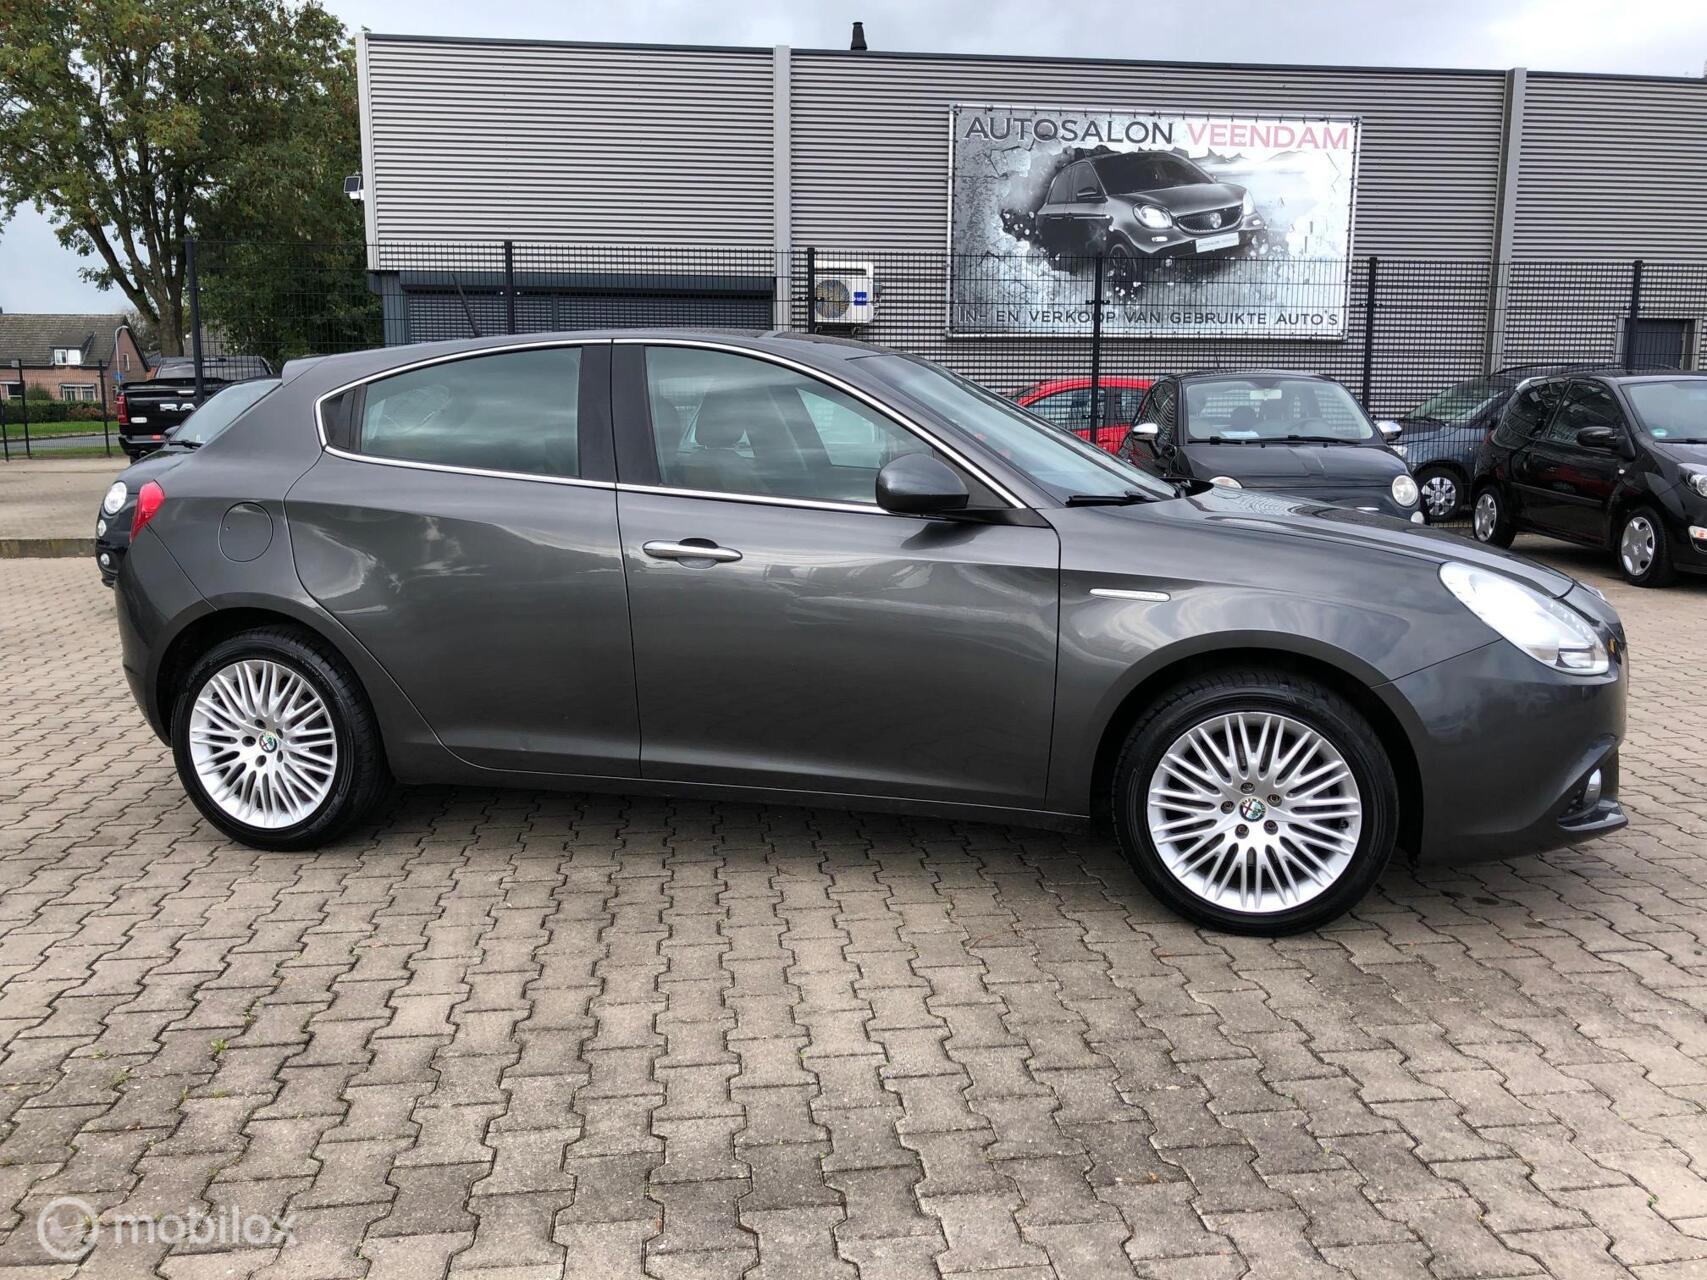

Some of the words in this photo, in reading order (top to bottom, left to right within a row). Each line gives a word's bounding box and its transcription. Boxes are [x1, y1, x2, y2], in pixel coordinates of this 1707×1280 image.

[963, 116, 1173, 145] AUTOSALON
[1187, 122, 1349, 150] VEENDAM
[996, 310, 1019, 323] EN
[1125, 311, 1160, 323] VAN
[1169, 312, 1267, 325] GEBRUIKTE
[1275, 310, 1338, 326] AUTO'S
